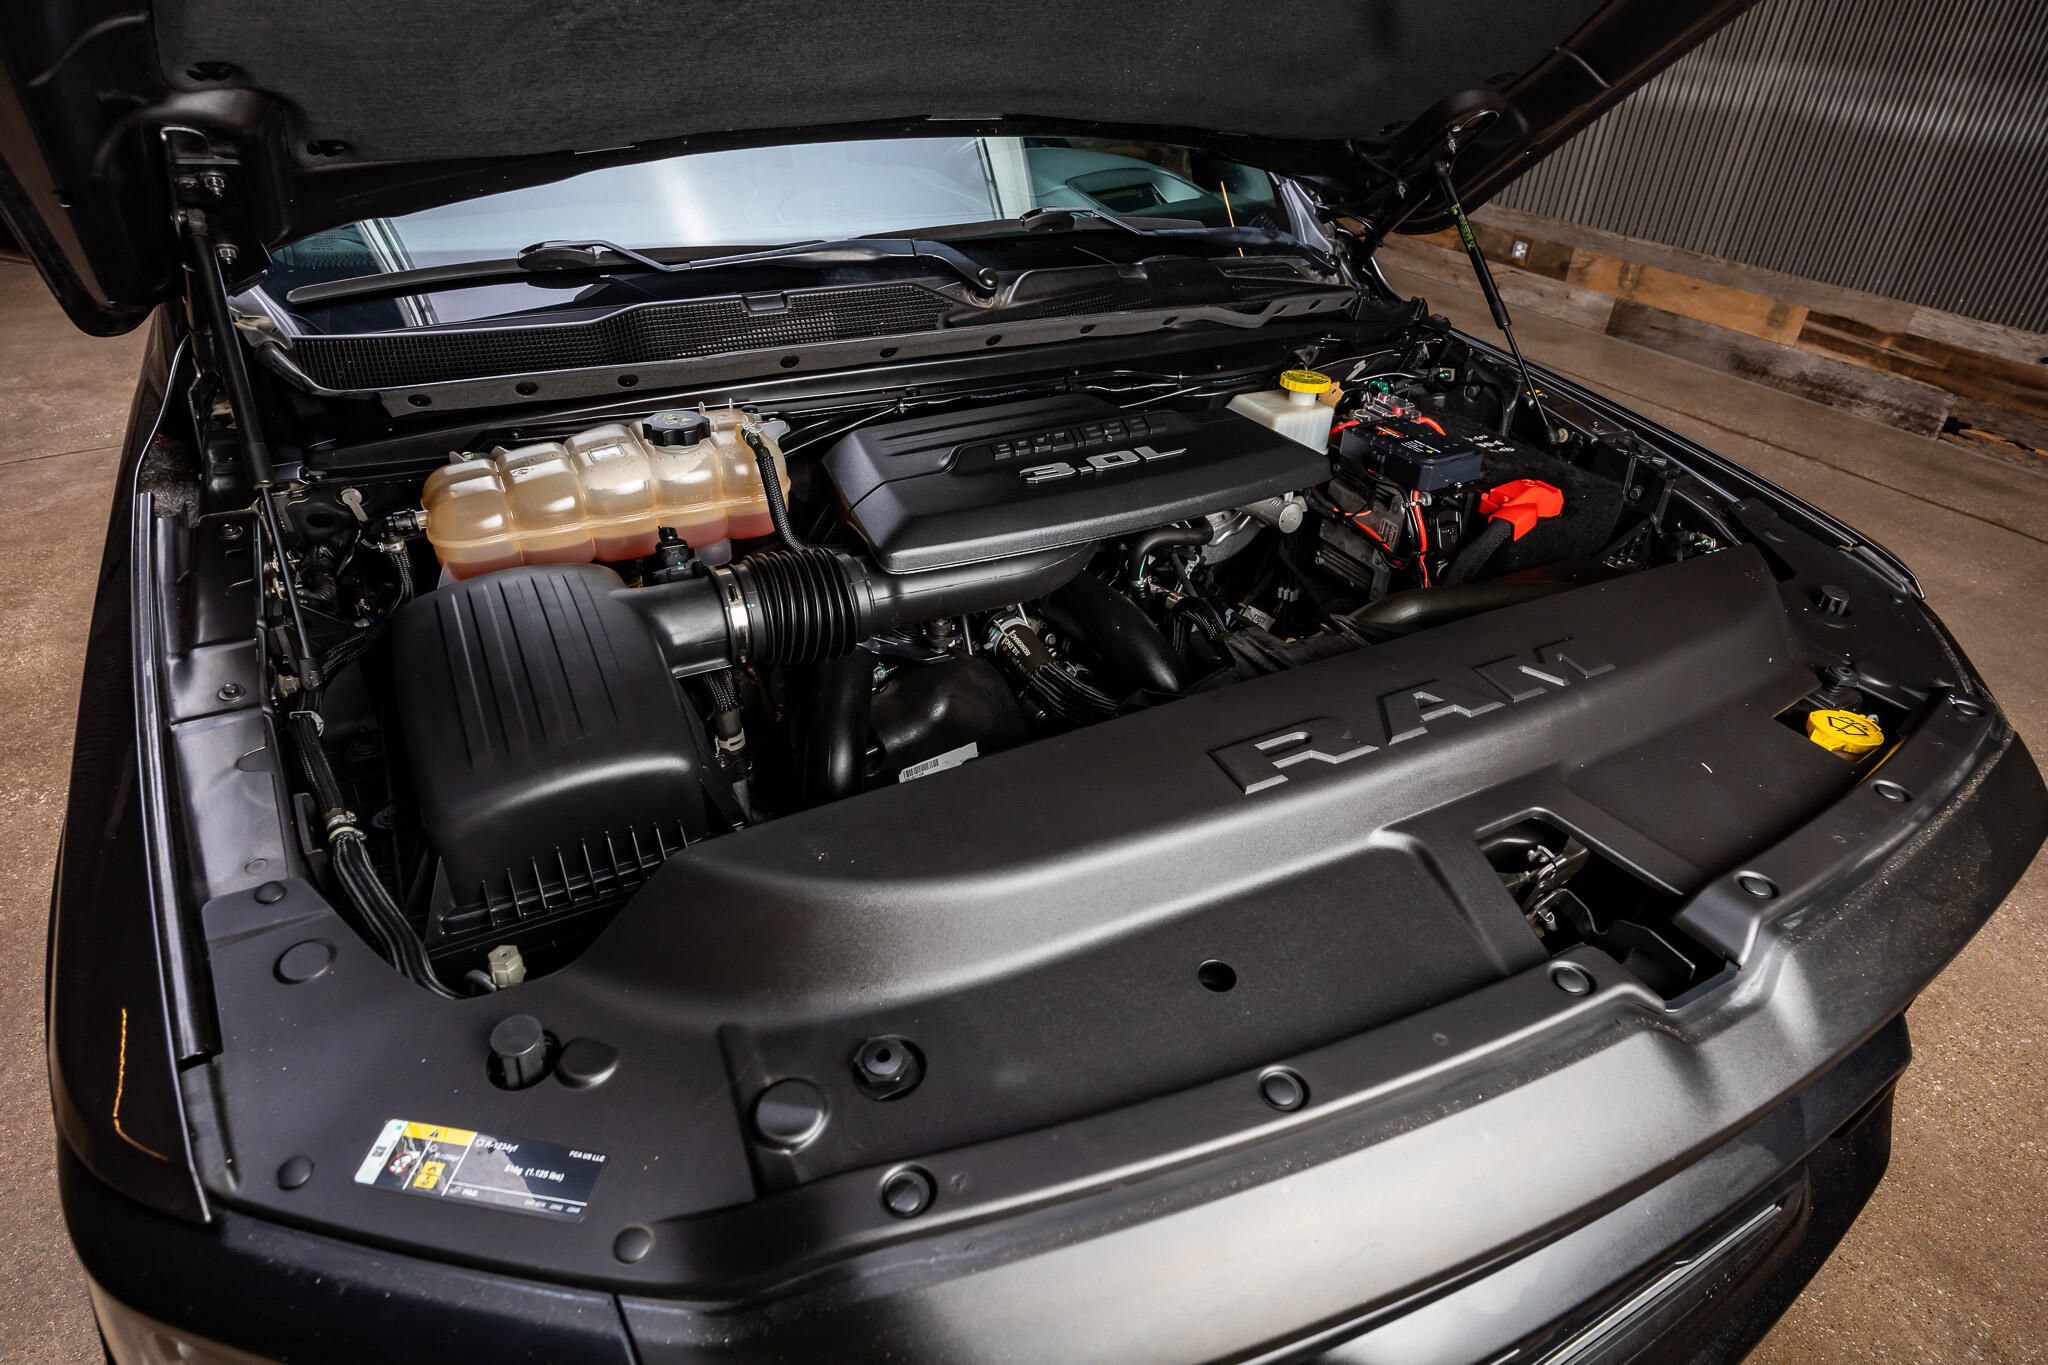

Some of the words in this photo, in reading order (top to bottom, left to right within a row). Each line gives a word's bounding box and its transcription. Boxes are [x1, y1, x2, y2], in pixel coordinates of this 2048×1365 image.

[990, 415, 1168, 461] ECODIESEL
[1019, 445, 1187, 484] 3.0L
[1207, 634, 1618, 795] RAM
